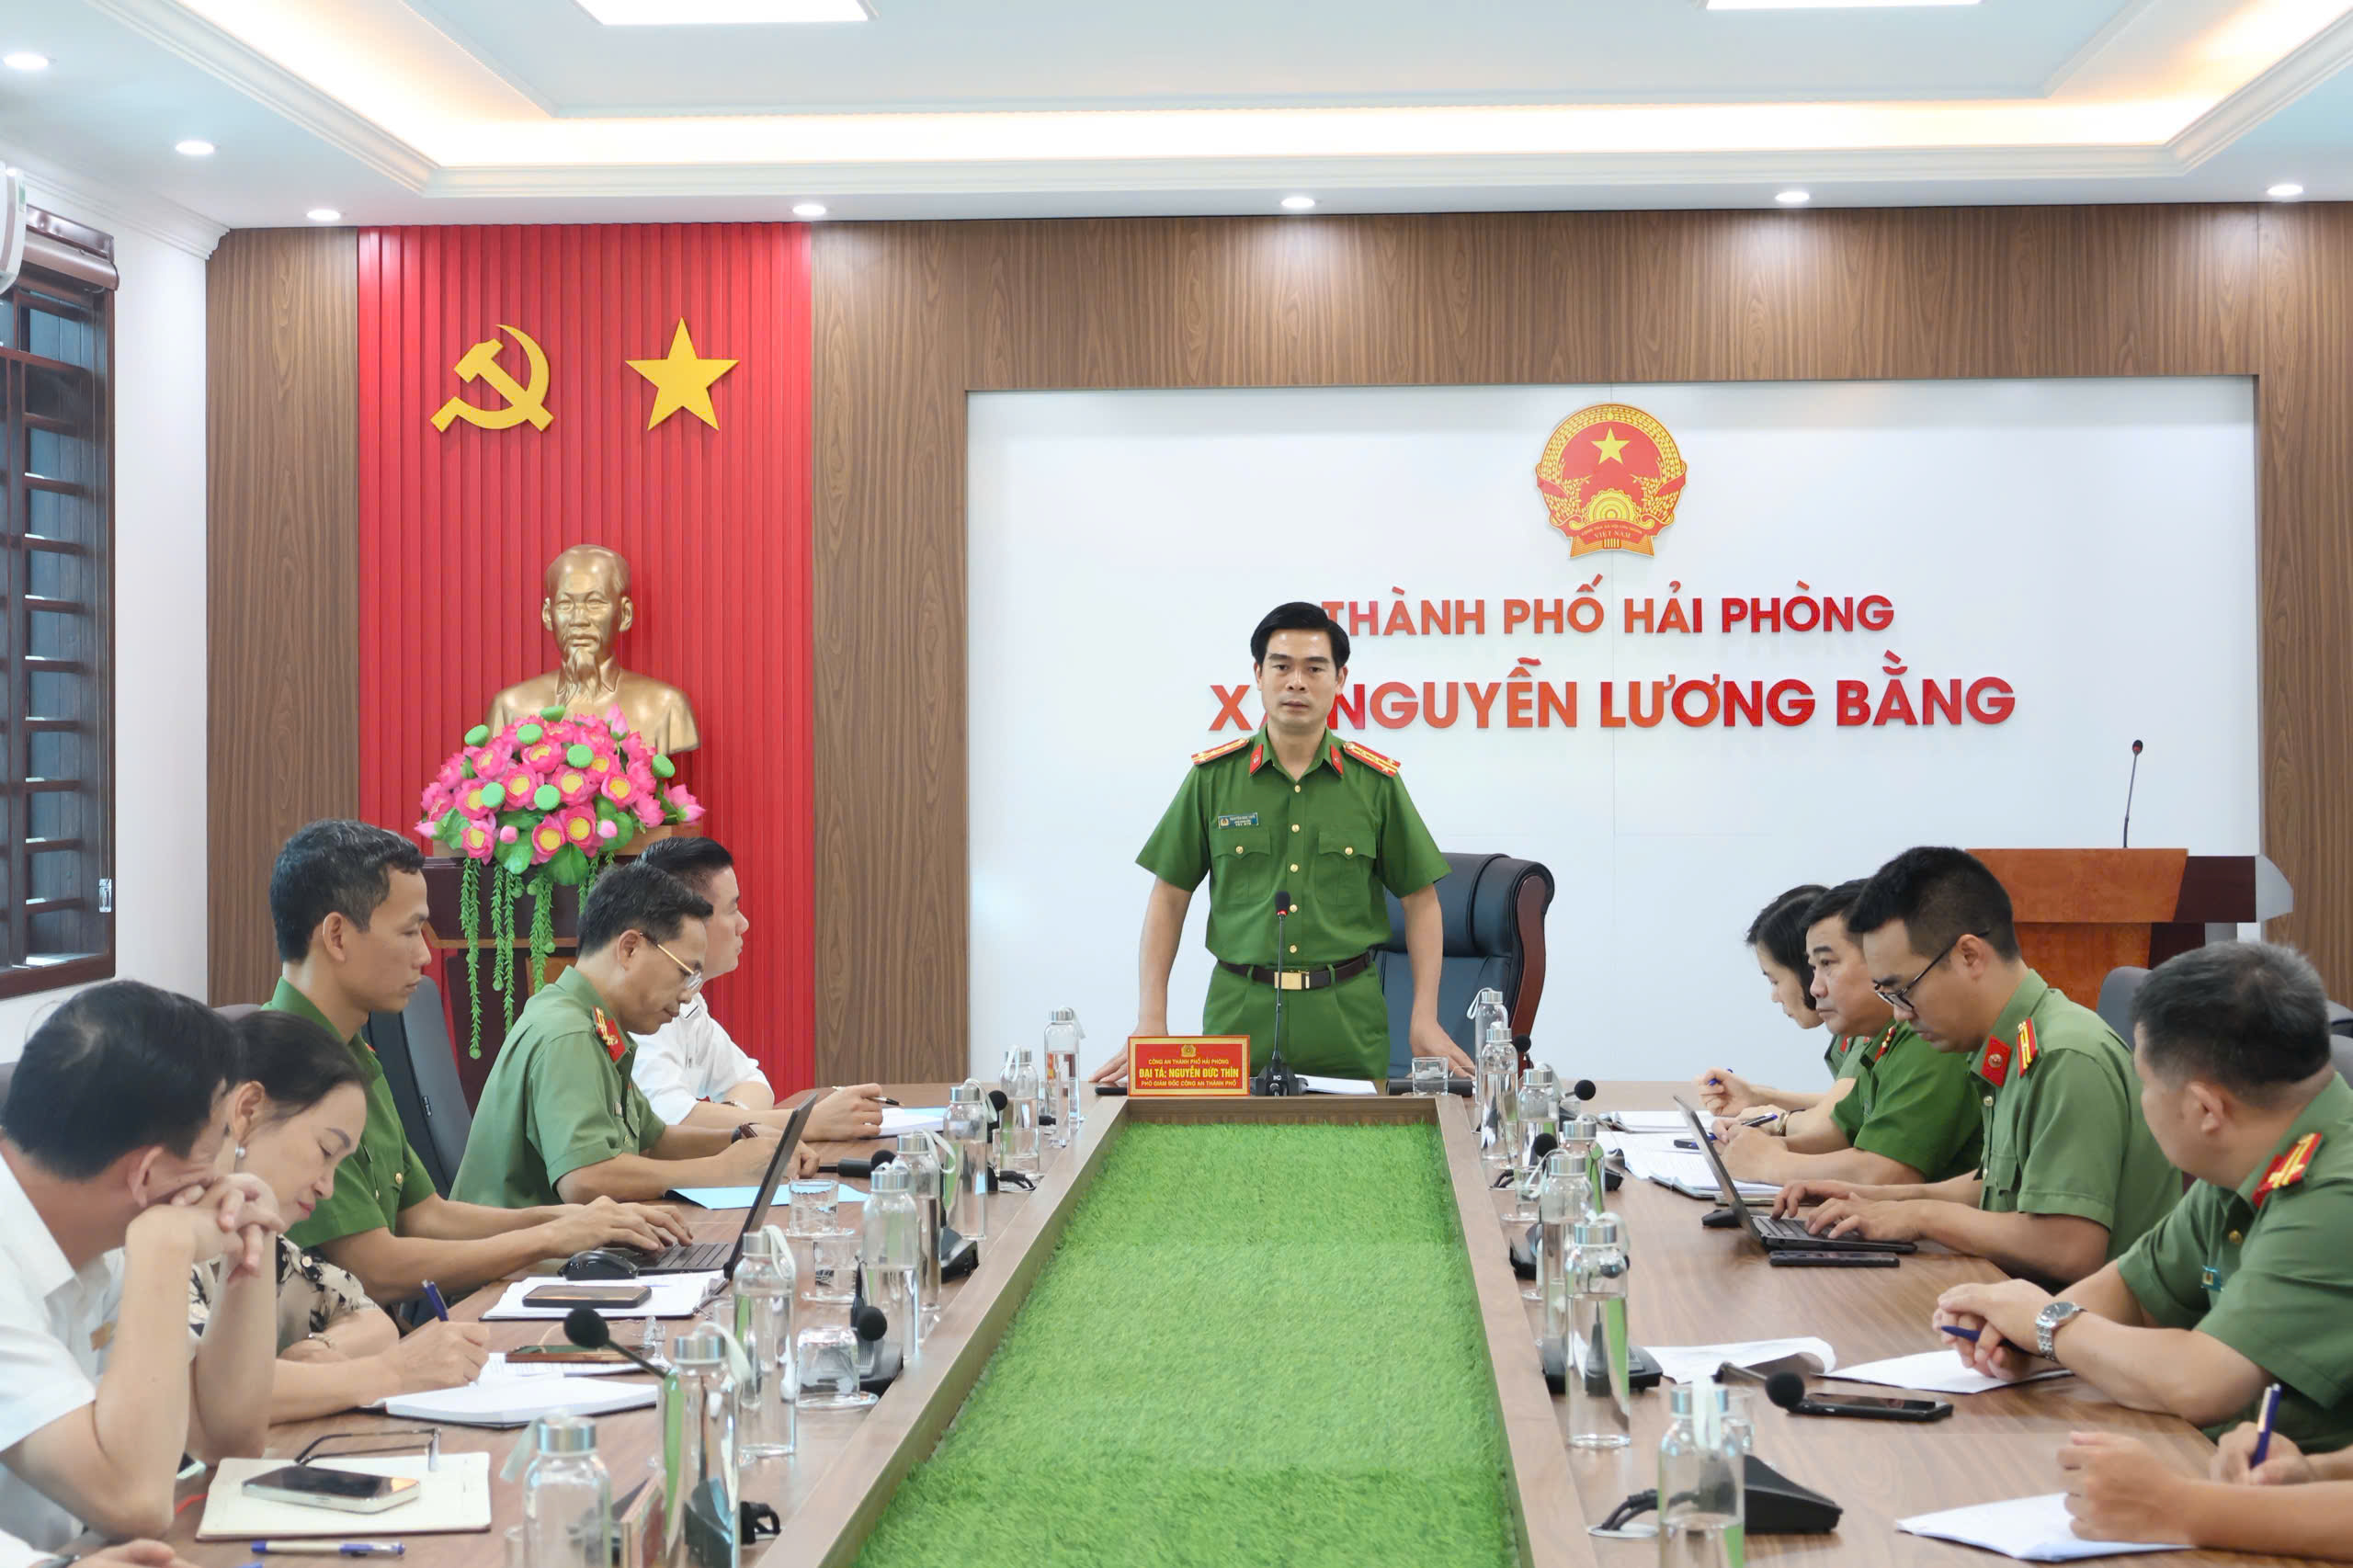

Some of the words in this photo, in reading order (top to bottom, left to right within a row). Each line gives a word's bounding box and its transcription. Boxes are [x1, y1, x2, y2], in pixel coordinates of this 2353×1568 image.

[1322, 586, 1484, 636] THÀNH
[1504, 574, 1605, 634] PHỐ
[1624, 580, 1703, 634] HẢI
[1722, 579, 1894, 634] PHÒNG
[1209, 684, 1268, 732] X
[1326, 656, 1577, 731] NGUYỄN
[1600, 673, 1815, 729] LƯƠNG
[1836, 649, 2017, 727] BẰNG
[1139, 1068, 1153, 1080] ĐẠI
[1154, 1066, 1167, 1078] TÁ:
[1168, 1064, 1200, 1078] NGUYỄN
[1202, 1066, 1219, 1078] ĐỨC
